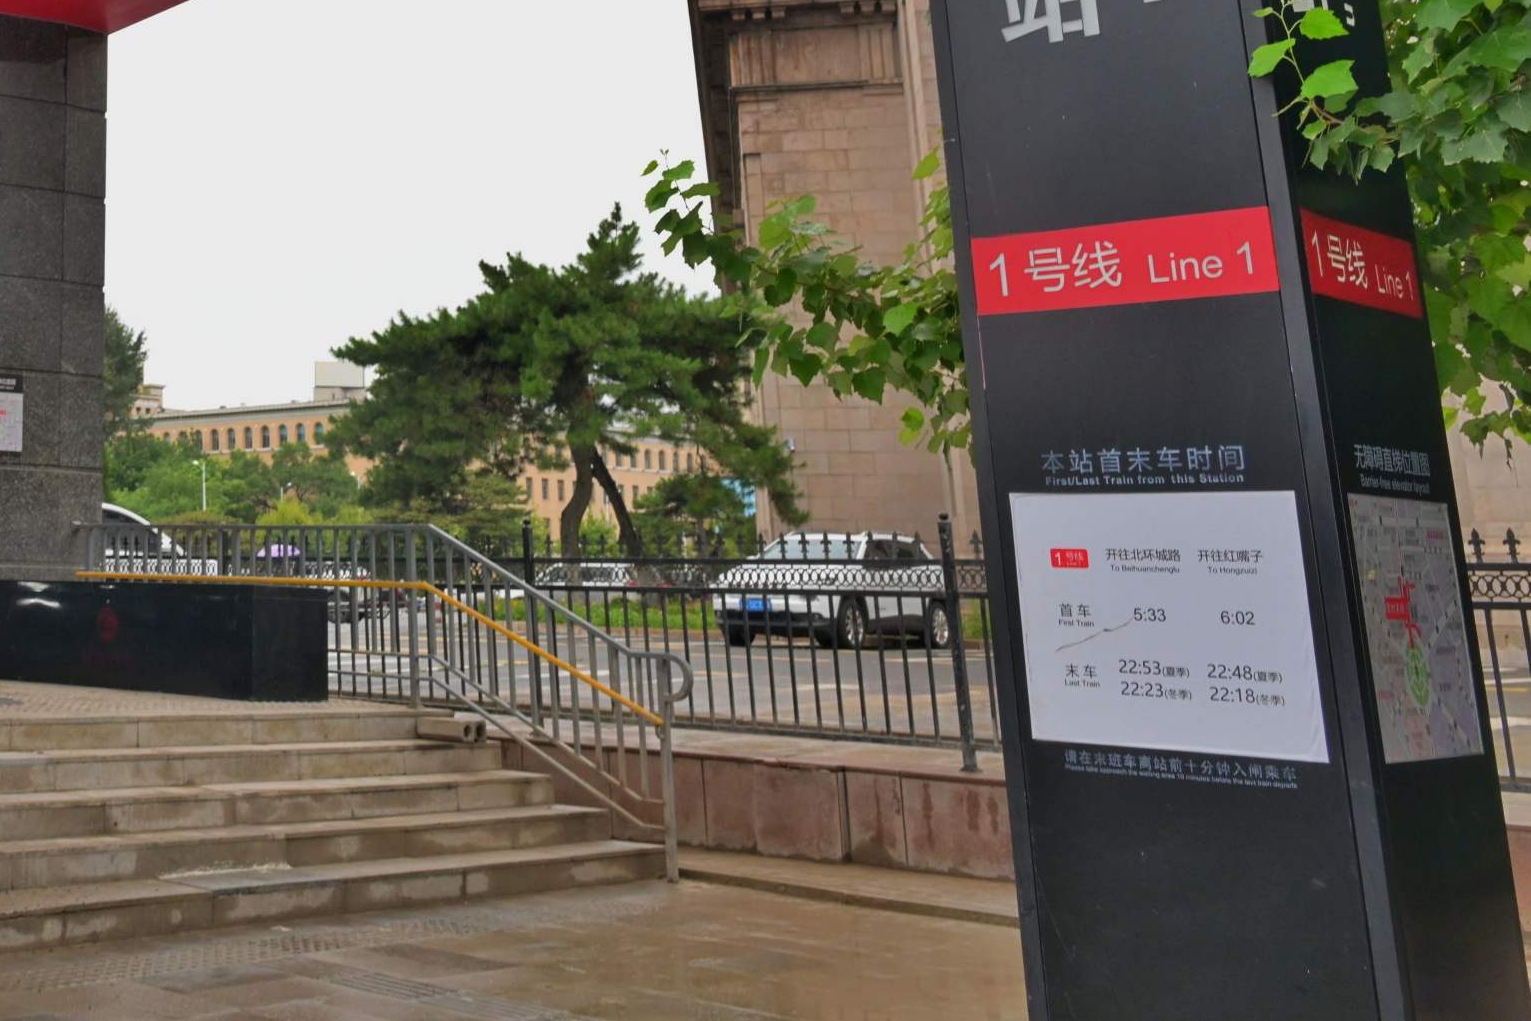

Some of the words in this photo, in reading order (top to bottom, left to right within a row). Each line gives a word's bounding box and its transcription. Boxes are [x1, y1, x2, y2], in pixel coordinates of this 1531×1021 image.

[1148, 251, 1223, 284] Line
[1236, 241, 1254, 275] 1
[1311, 229, 1369, 290] 1号线
[990, 240, 1122, 297] 1号线
[1375, 264, 1405, 299] Line
[1405, 271, 1414, 300] 1
[1041, 444, 1246, 475] 本站首末车时间
[1045, 476, 1100, 486] First/Last
[1103, 475, 1134, 486] Train
[1138, 474, 1165, 485] from
[1171, 474, 1195, 485] this
[1199, 473, 1245, 484] Station
[1106, 548, 1181, 562] 开往北环城路
[1198, 549, 1263, 564] 开往红嘴子
[1133, 607, 1167, 622] 5:33
[1220, 610, 1256, 626] 6:02
[1076, 619, 1095, 628] Train
[1082, 679, 1101, 688] Train
